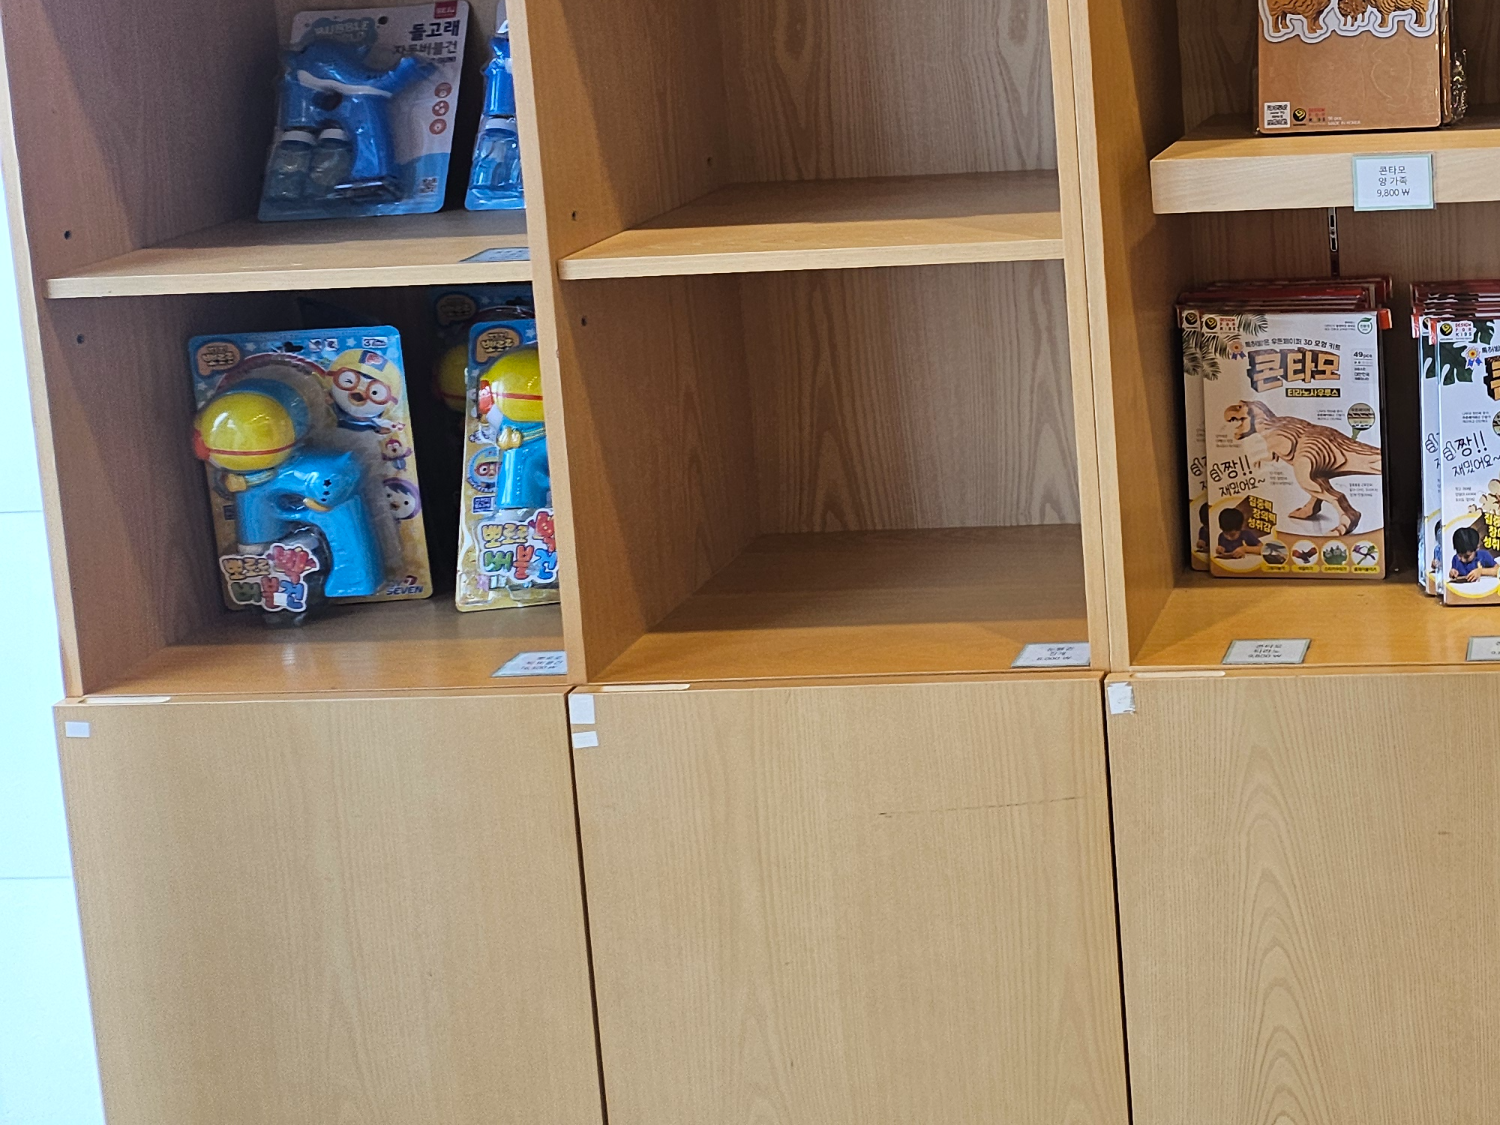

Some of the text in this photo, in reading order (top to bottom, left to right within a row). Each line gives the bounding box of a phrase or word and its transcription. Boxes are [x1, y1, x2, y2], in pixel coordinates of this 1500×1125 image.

[408, 19, 460, 42] 돌고래
[1378, 165, 1406, 176] 콘타모
[1378, 175, 1408, 187] 양 가족
[1377, 188, 1400, 199] 9,800
[1303, 338, 1313, 346] 3D
[1314, 340, 1327, 348] 모형
[1248, 348, 1341, 393] 콘타모
[1287, 388, 1339, 397] 티라노사우루스
[1454, 430, 1488, 457] 짱!!
[1221, 455, 1253, 479] 짱!!
[1248, 495, 1274, 512] 집중력
[1252, 508, 1277, 524] 창의력
[1247, 517, 1272, 533] 성취감
[386, 585, 424, 595] SEVEN
